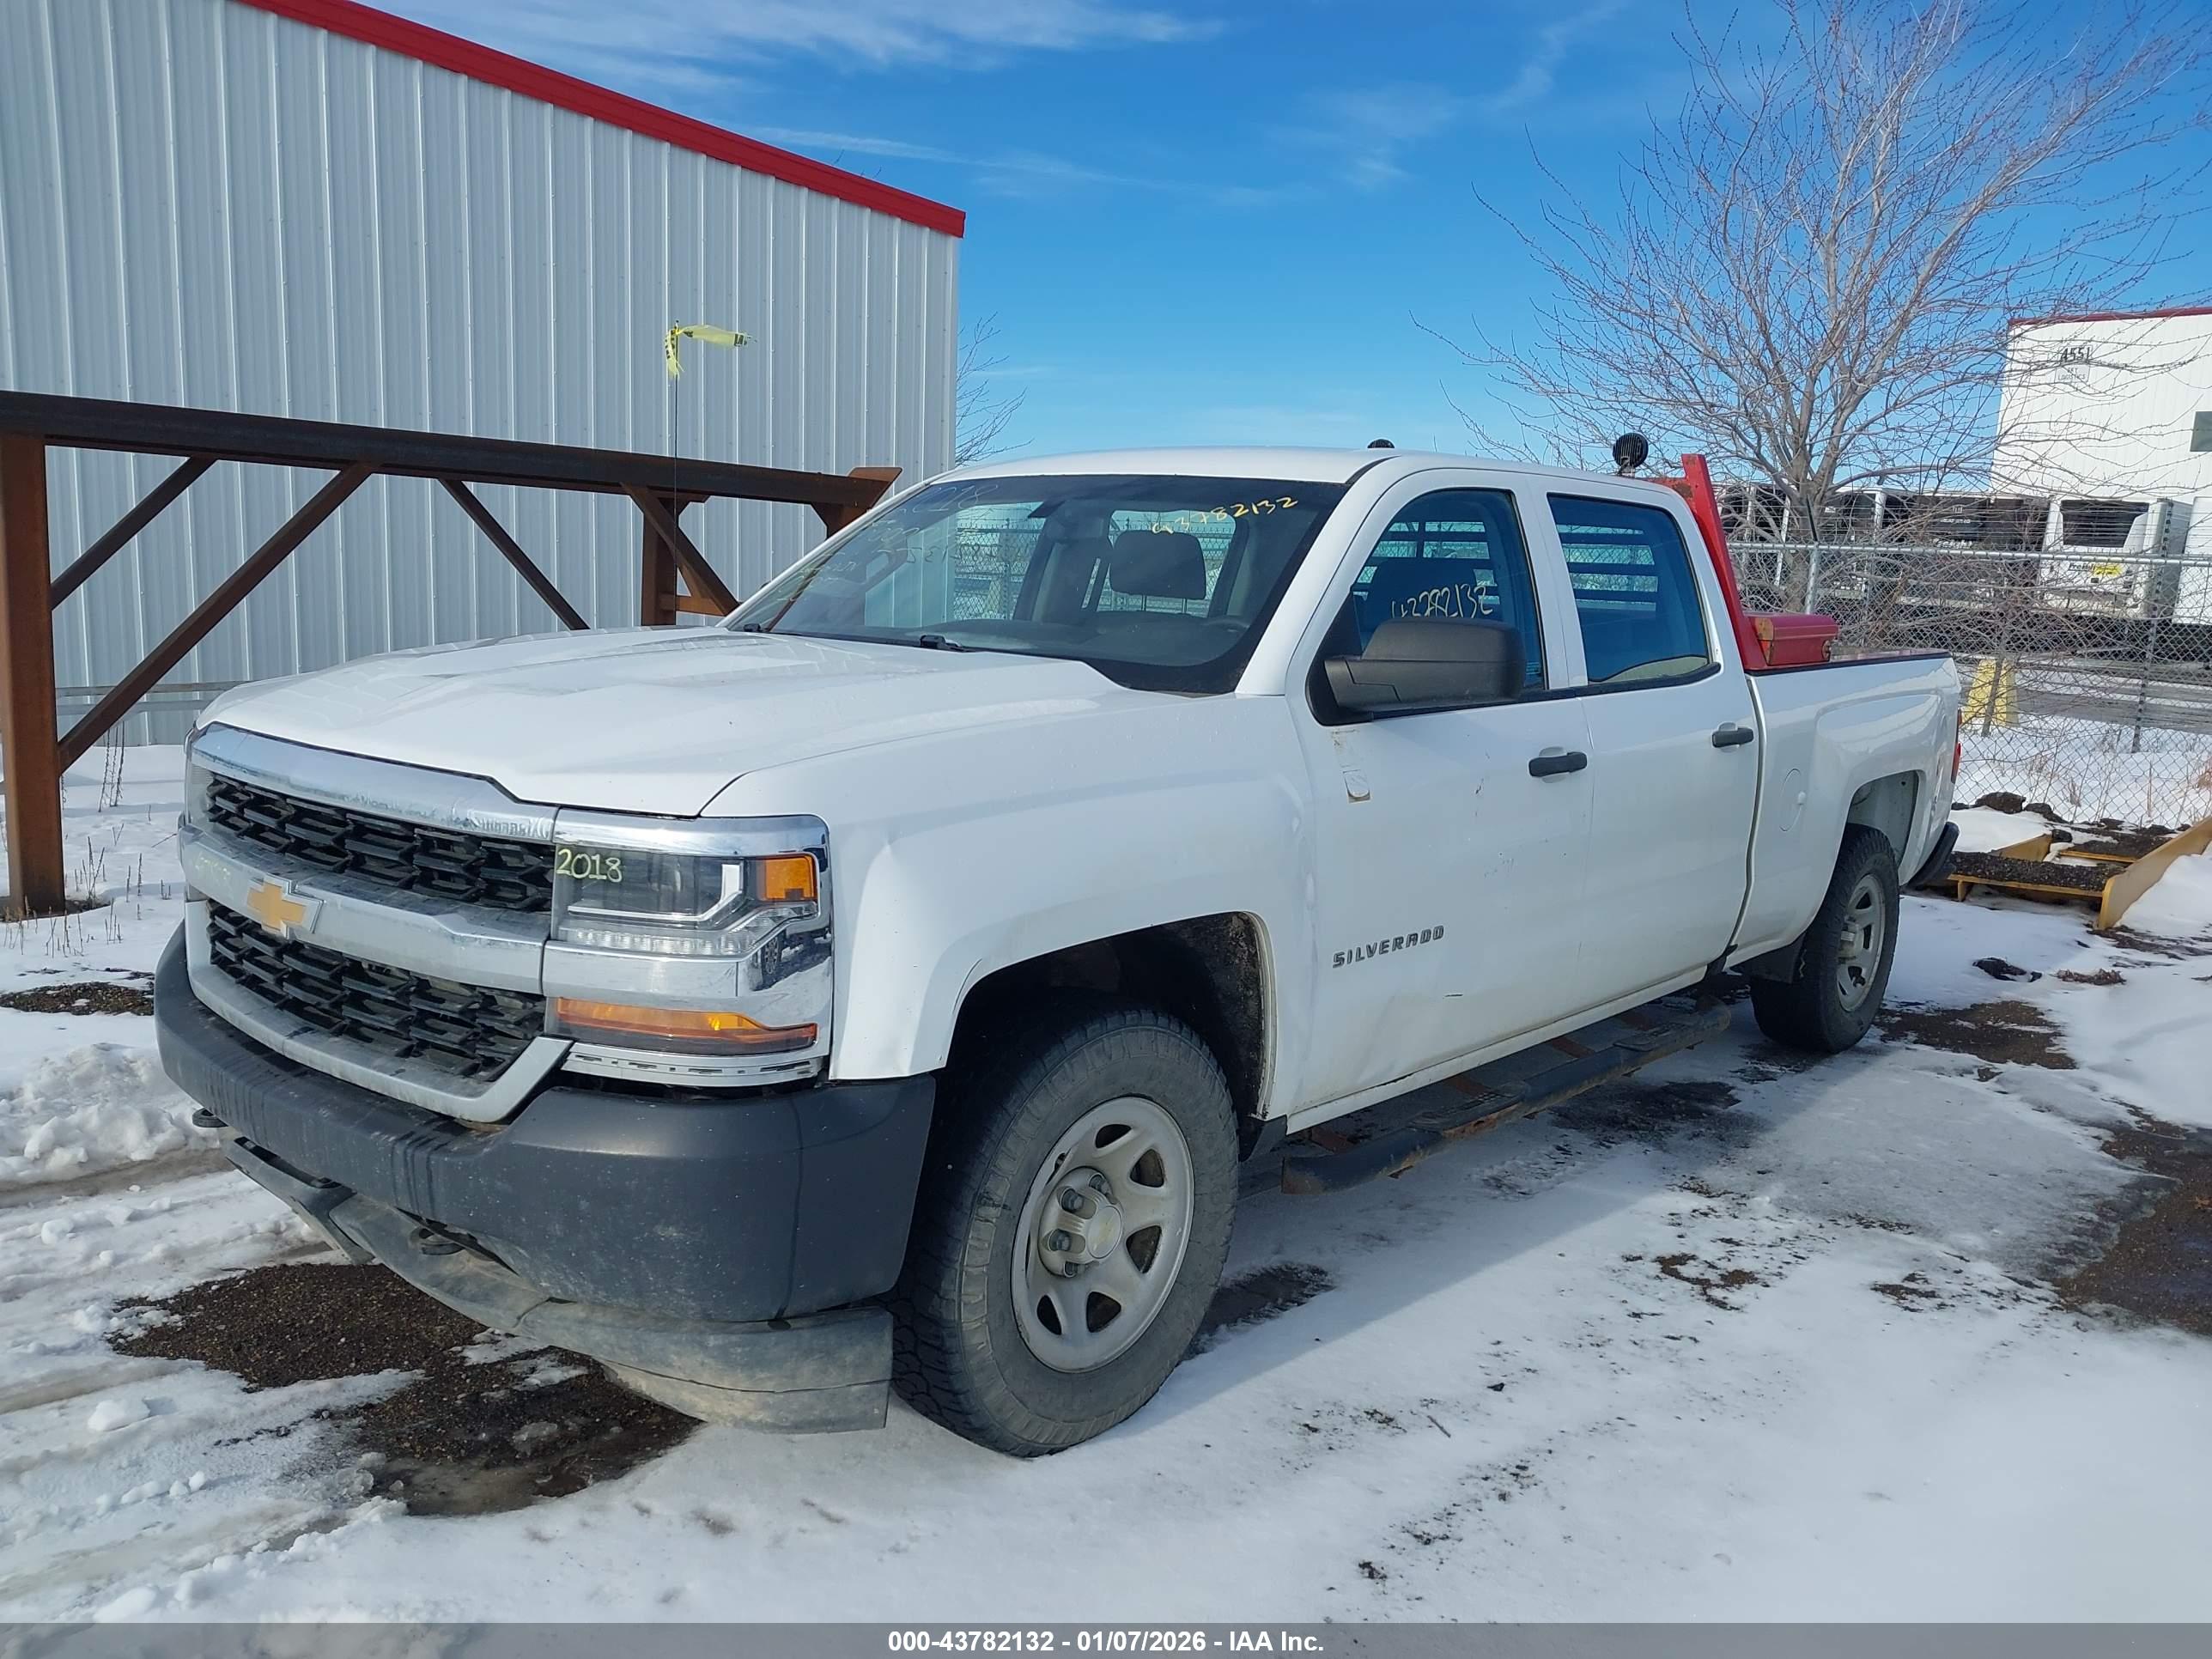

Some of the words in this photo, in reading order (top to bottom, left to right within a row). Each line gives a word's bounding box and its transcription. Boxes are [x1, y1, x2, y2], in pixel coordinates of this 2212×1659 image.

[2061, 346, 2090, 362] 4551
[556, 848, 623, 882] 2018
[1332, 925, 1444, 969] SILVERADO
